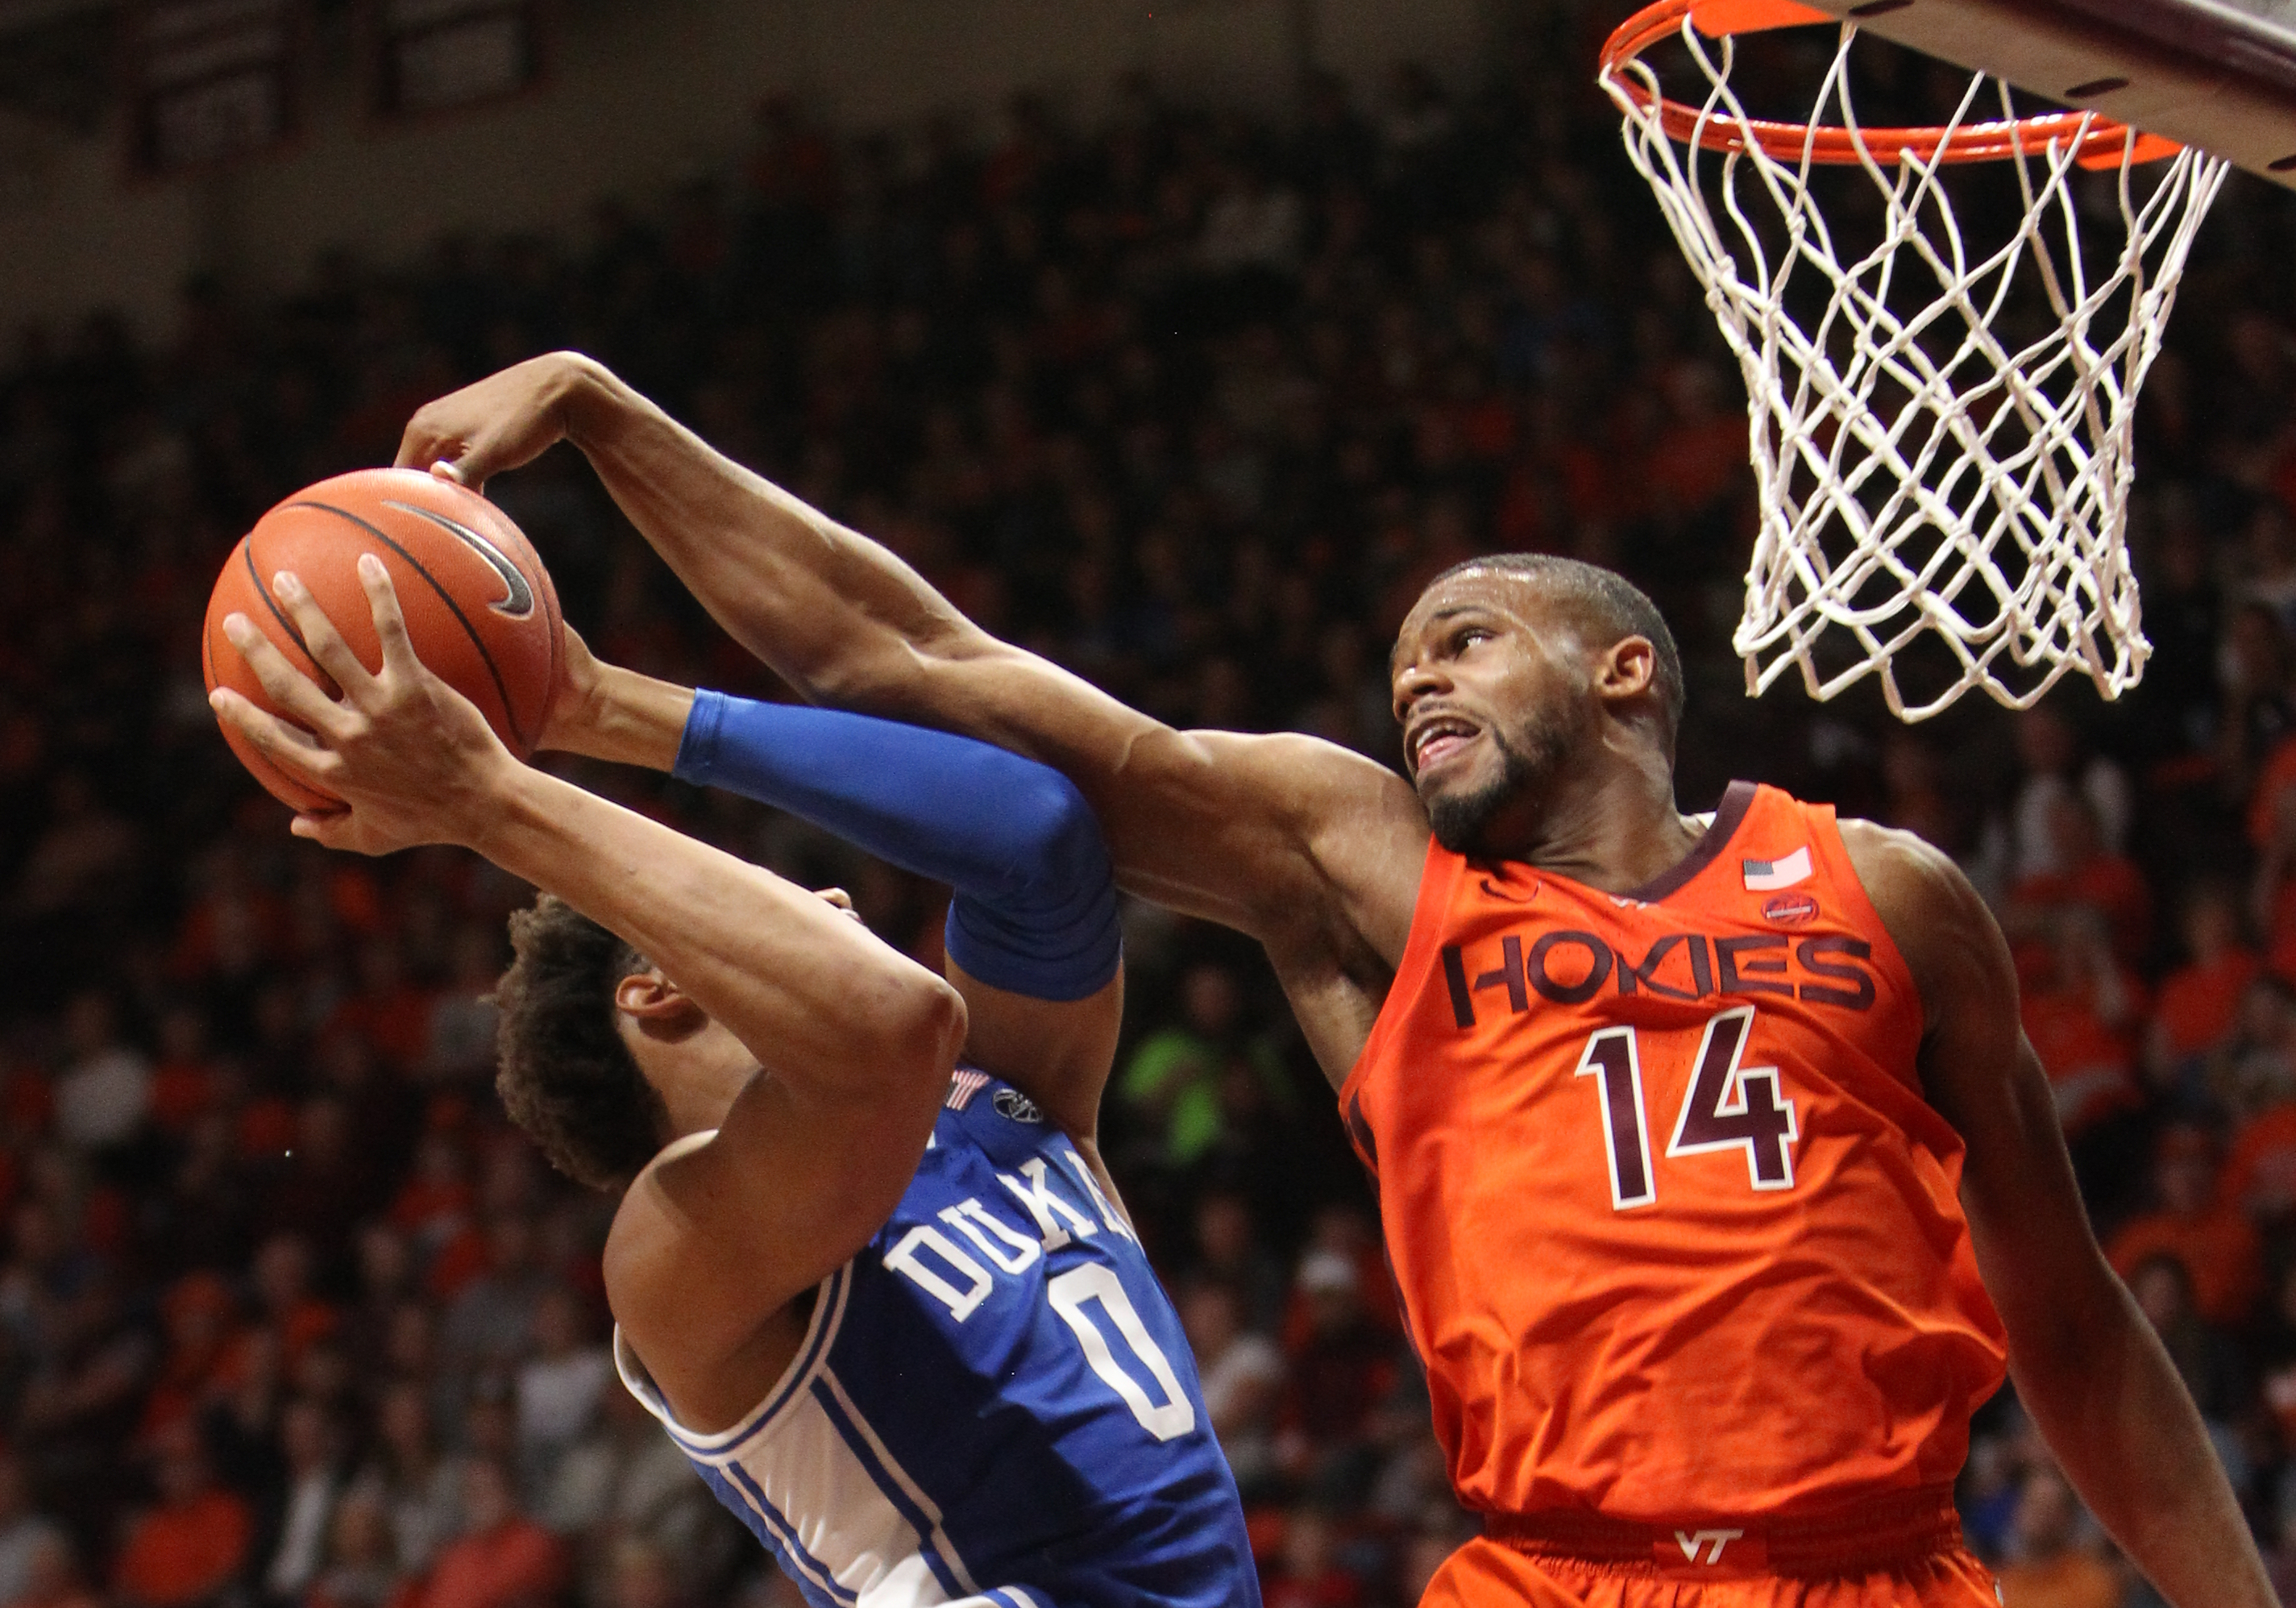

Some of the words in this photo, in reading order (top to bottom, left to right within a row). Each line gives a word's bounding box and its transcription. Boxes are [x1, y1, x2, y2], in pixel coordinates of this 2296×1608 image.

[1442, 929, 1876, 1030] HOKIES
[1574, 1005, 1798, 1210] 14
[1048, 1261, 1196, 1442] 0
[1674, 1528, 1745, 1565] VT
